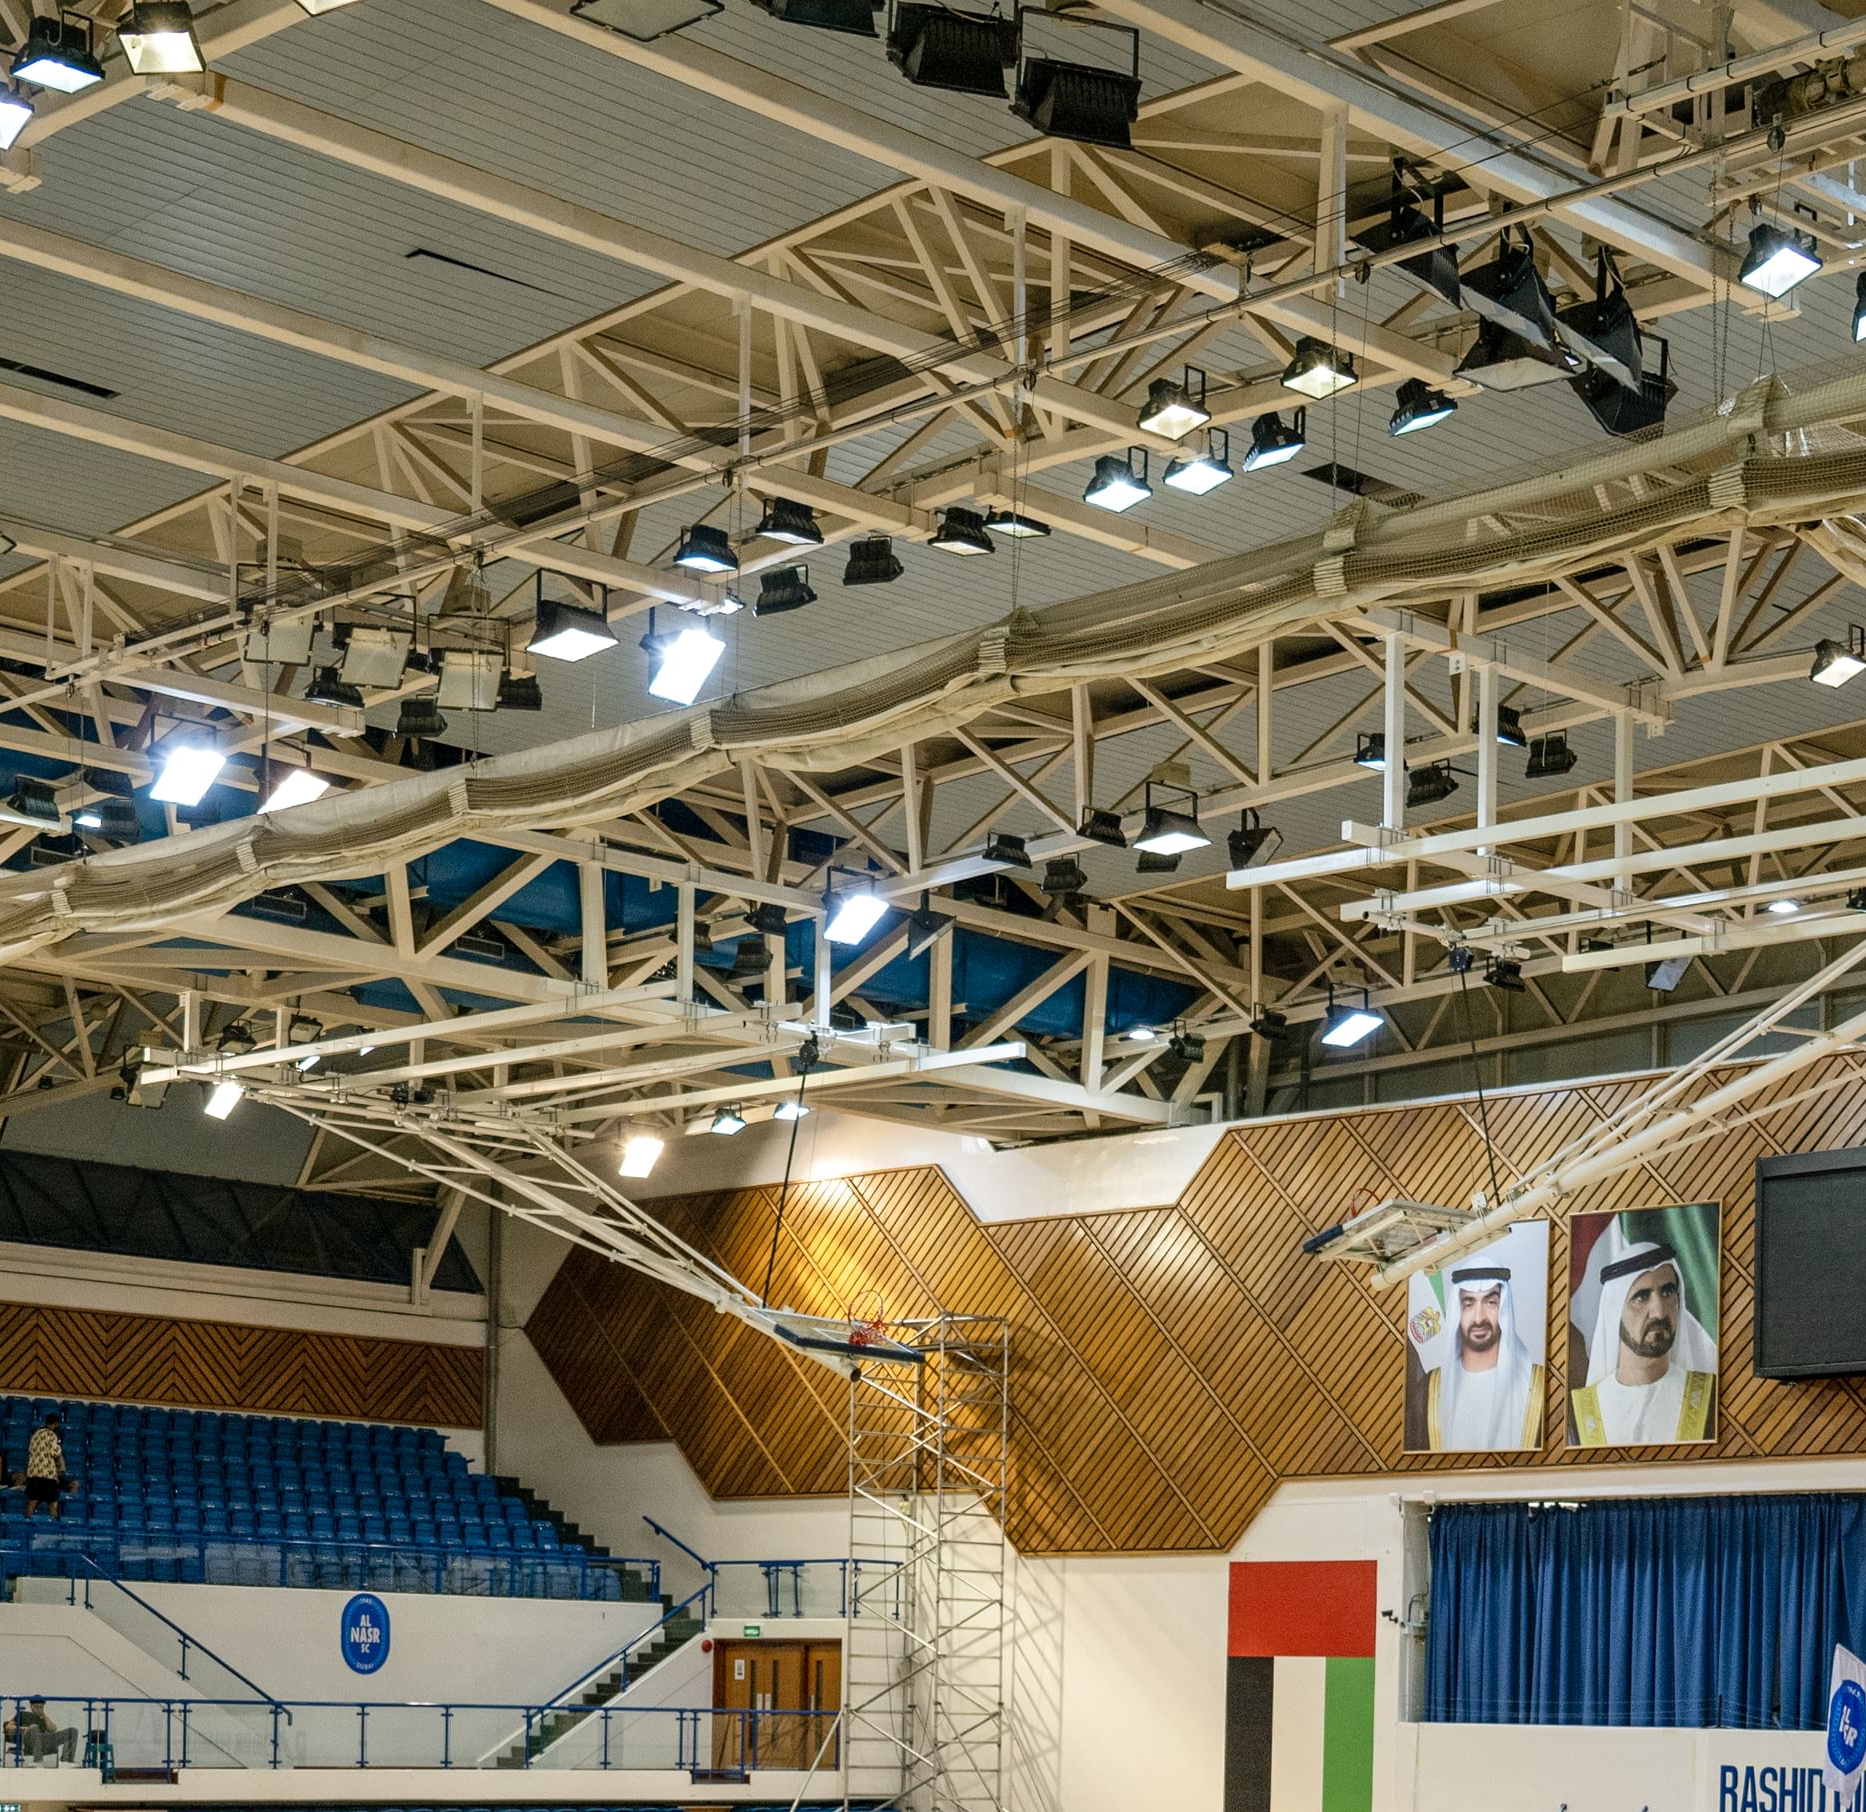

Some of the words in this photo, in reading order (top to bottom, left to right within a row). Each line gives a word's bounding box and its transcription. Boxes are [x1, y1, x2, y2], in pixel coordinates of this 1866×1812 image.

[360, 1614, 372, 1627] AL
[350, 1626, 380, 1643] NASR
[361, 1643, 370, 1654] SC
